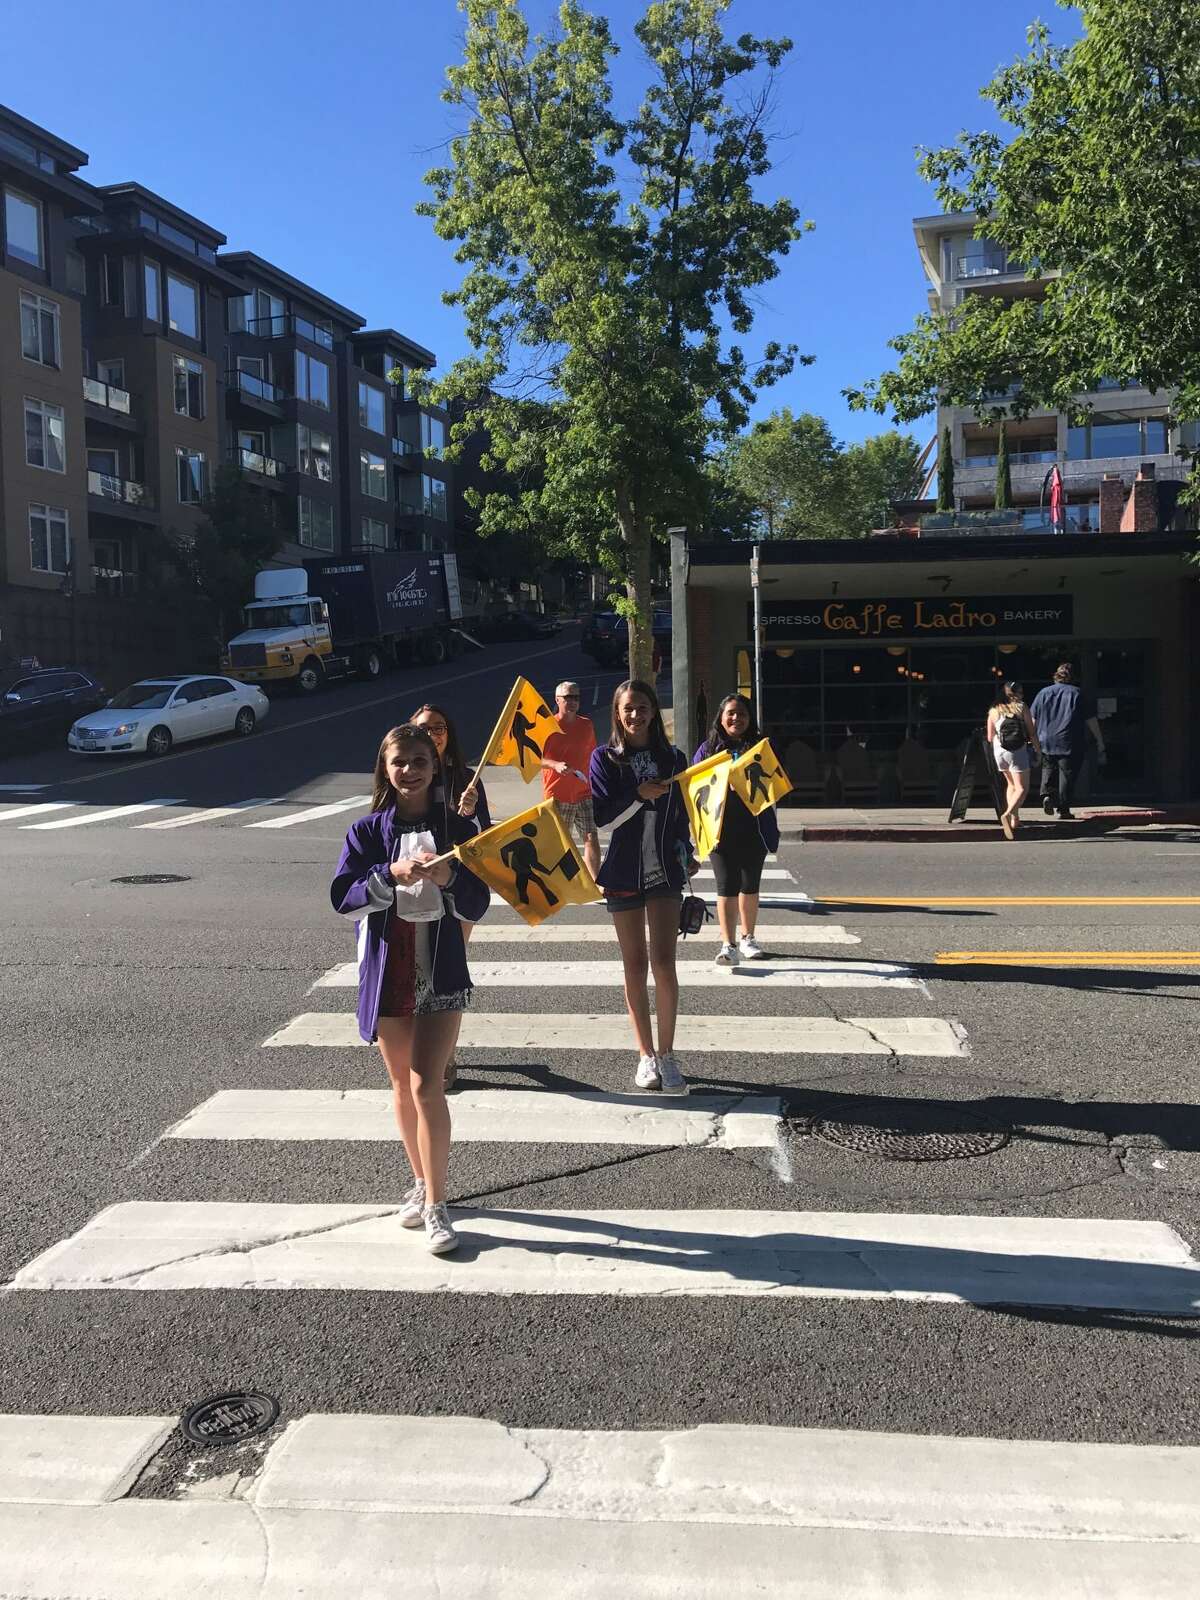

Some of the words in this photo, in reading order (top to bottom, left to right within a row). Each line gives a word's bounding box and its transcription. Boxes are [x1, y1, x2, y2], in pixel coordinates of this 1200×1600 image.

[757, 614, 821, 626] SPRESSO
[913, 601, 997, 628] Ladro
[1003, 609, 1063, 621] BAKERY
